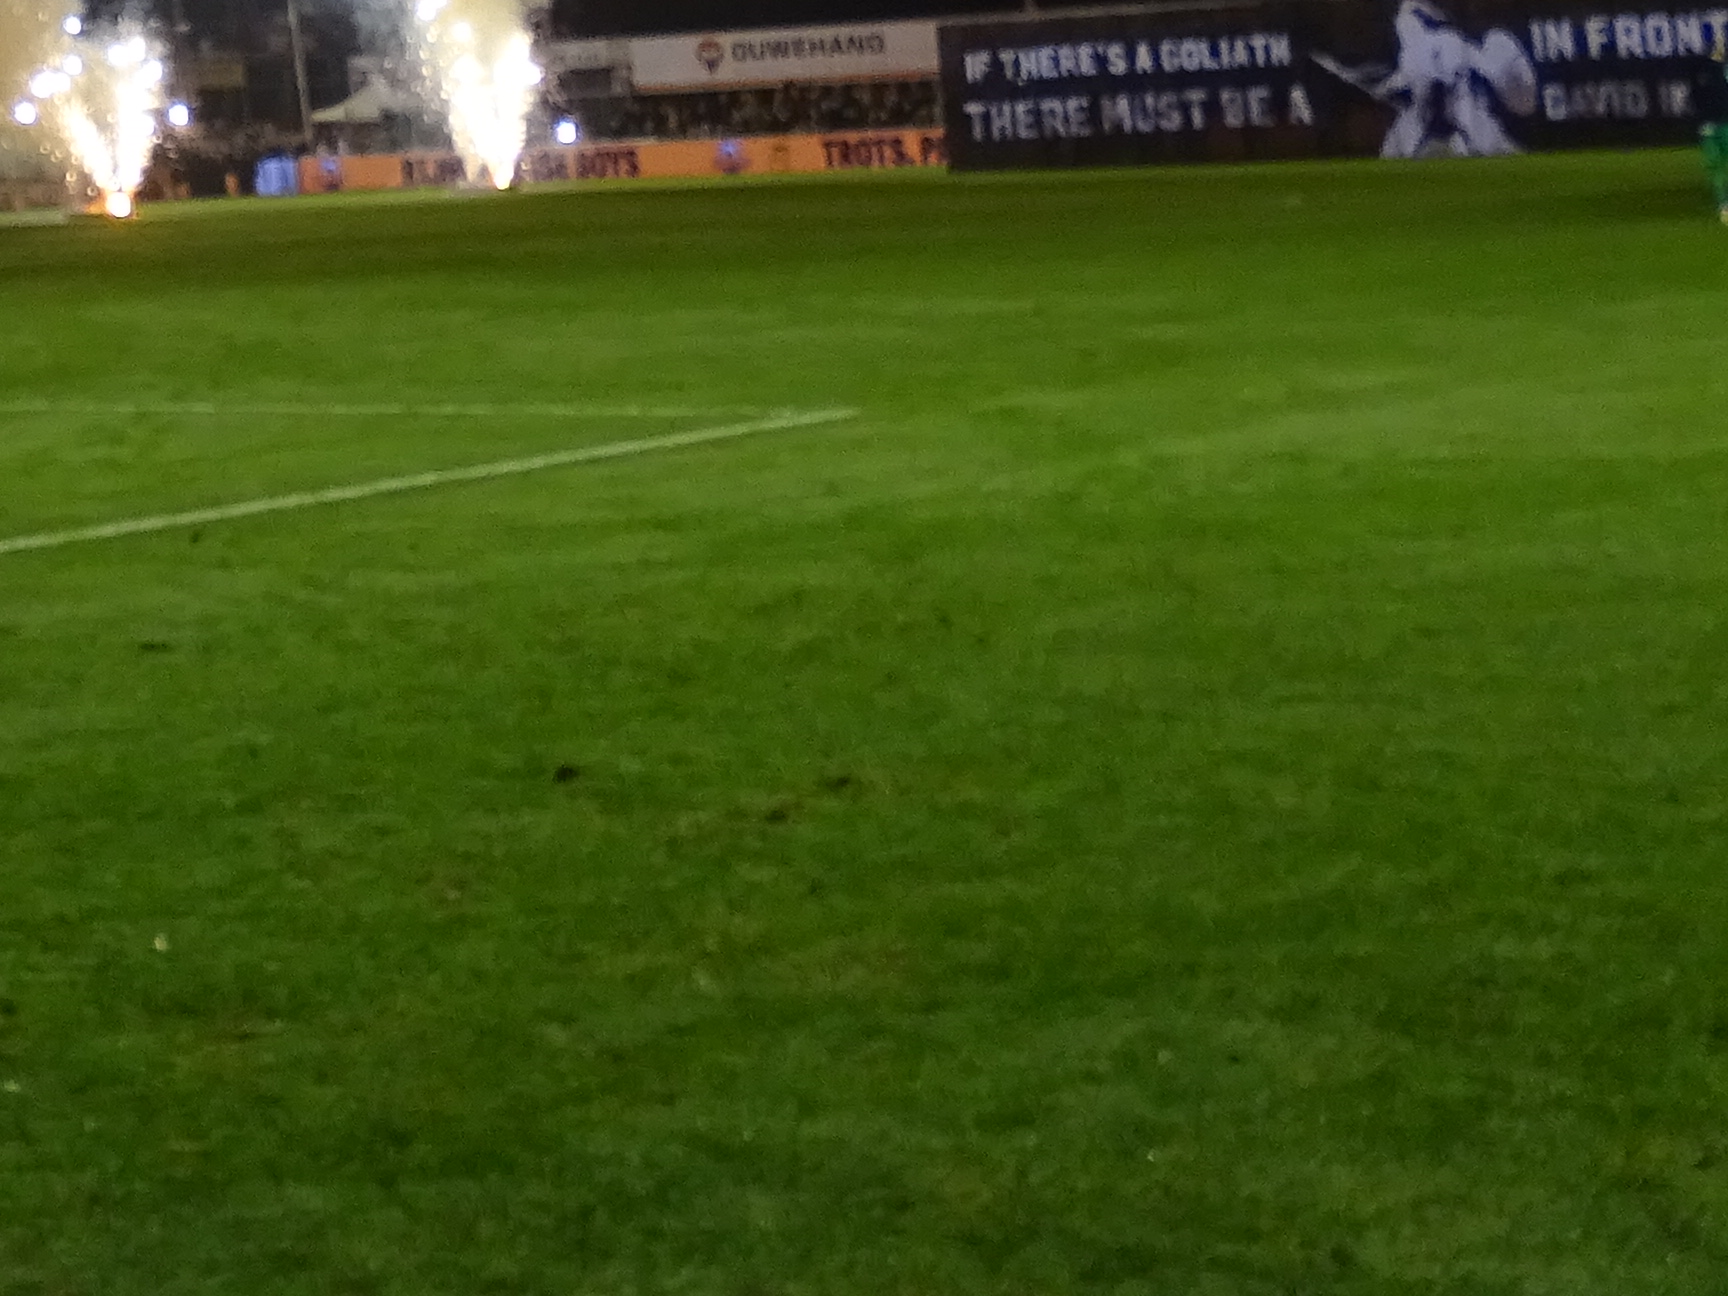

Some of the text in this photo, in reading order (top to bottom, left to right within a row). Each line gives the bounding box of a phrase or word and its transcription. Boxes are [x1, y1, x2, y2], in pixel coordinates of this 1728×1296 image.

[1135, 39, 1153, 74] A
[1529, 9, 1728, 62] IN FRONT
[963, 83, 1314, 141] THERE MUST BE A
